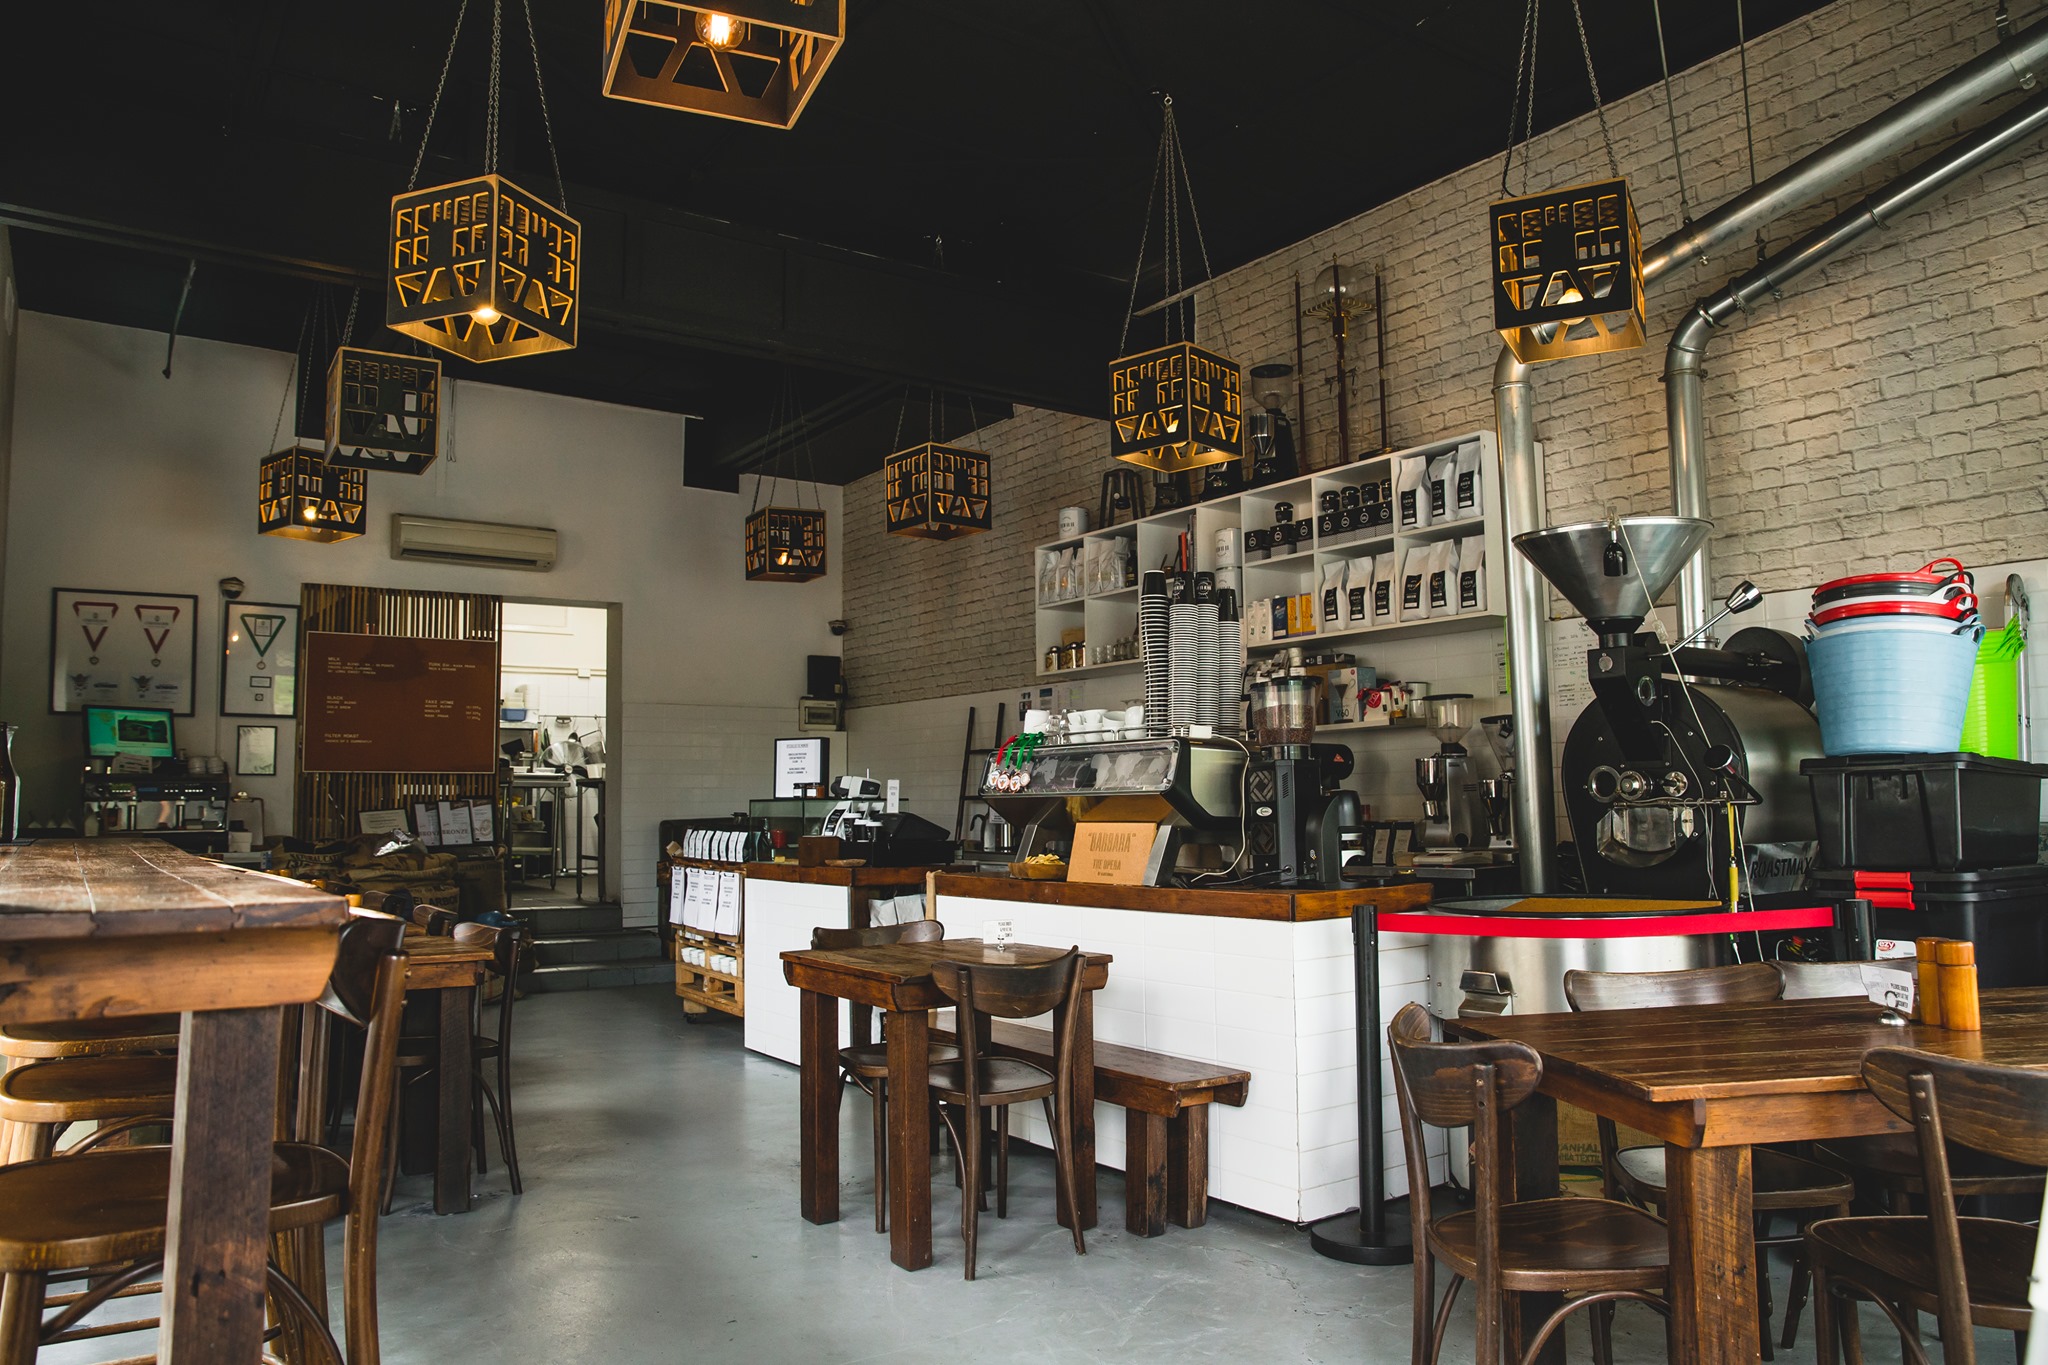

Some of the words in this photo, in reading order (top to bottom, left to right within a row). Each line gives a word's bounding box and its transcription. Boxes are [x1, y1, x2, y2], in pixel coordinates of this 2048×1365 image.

[1092, 859, 1102, 870] THE
[1103, 859, 1121, 870] OPERA
[1750, 856, 1812, 880] ROASTMAX
